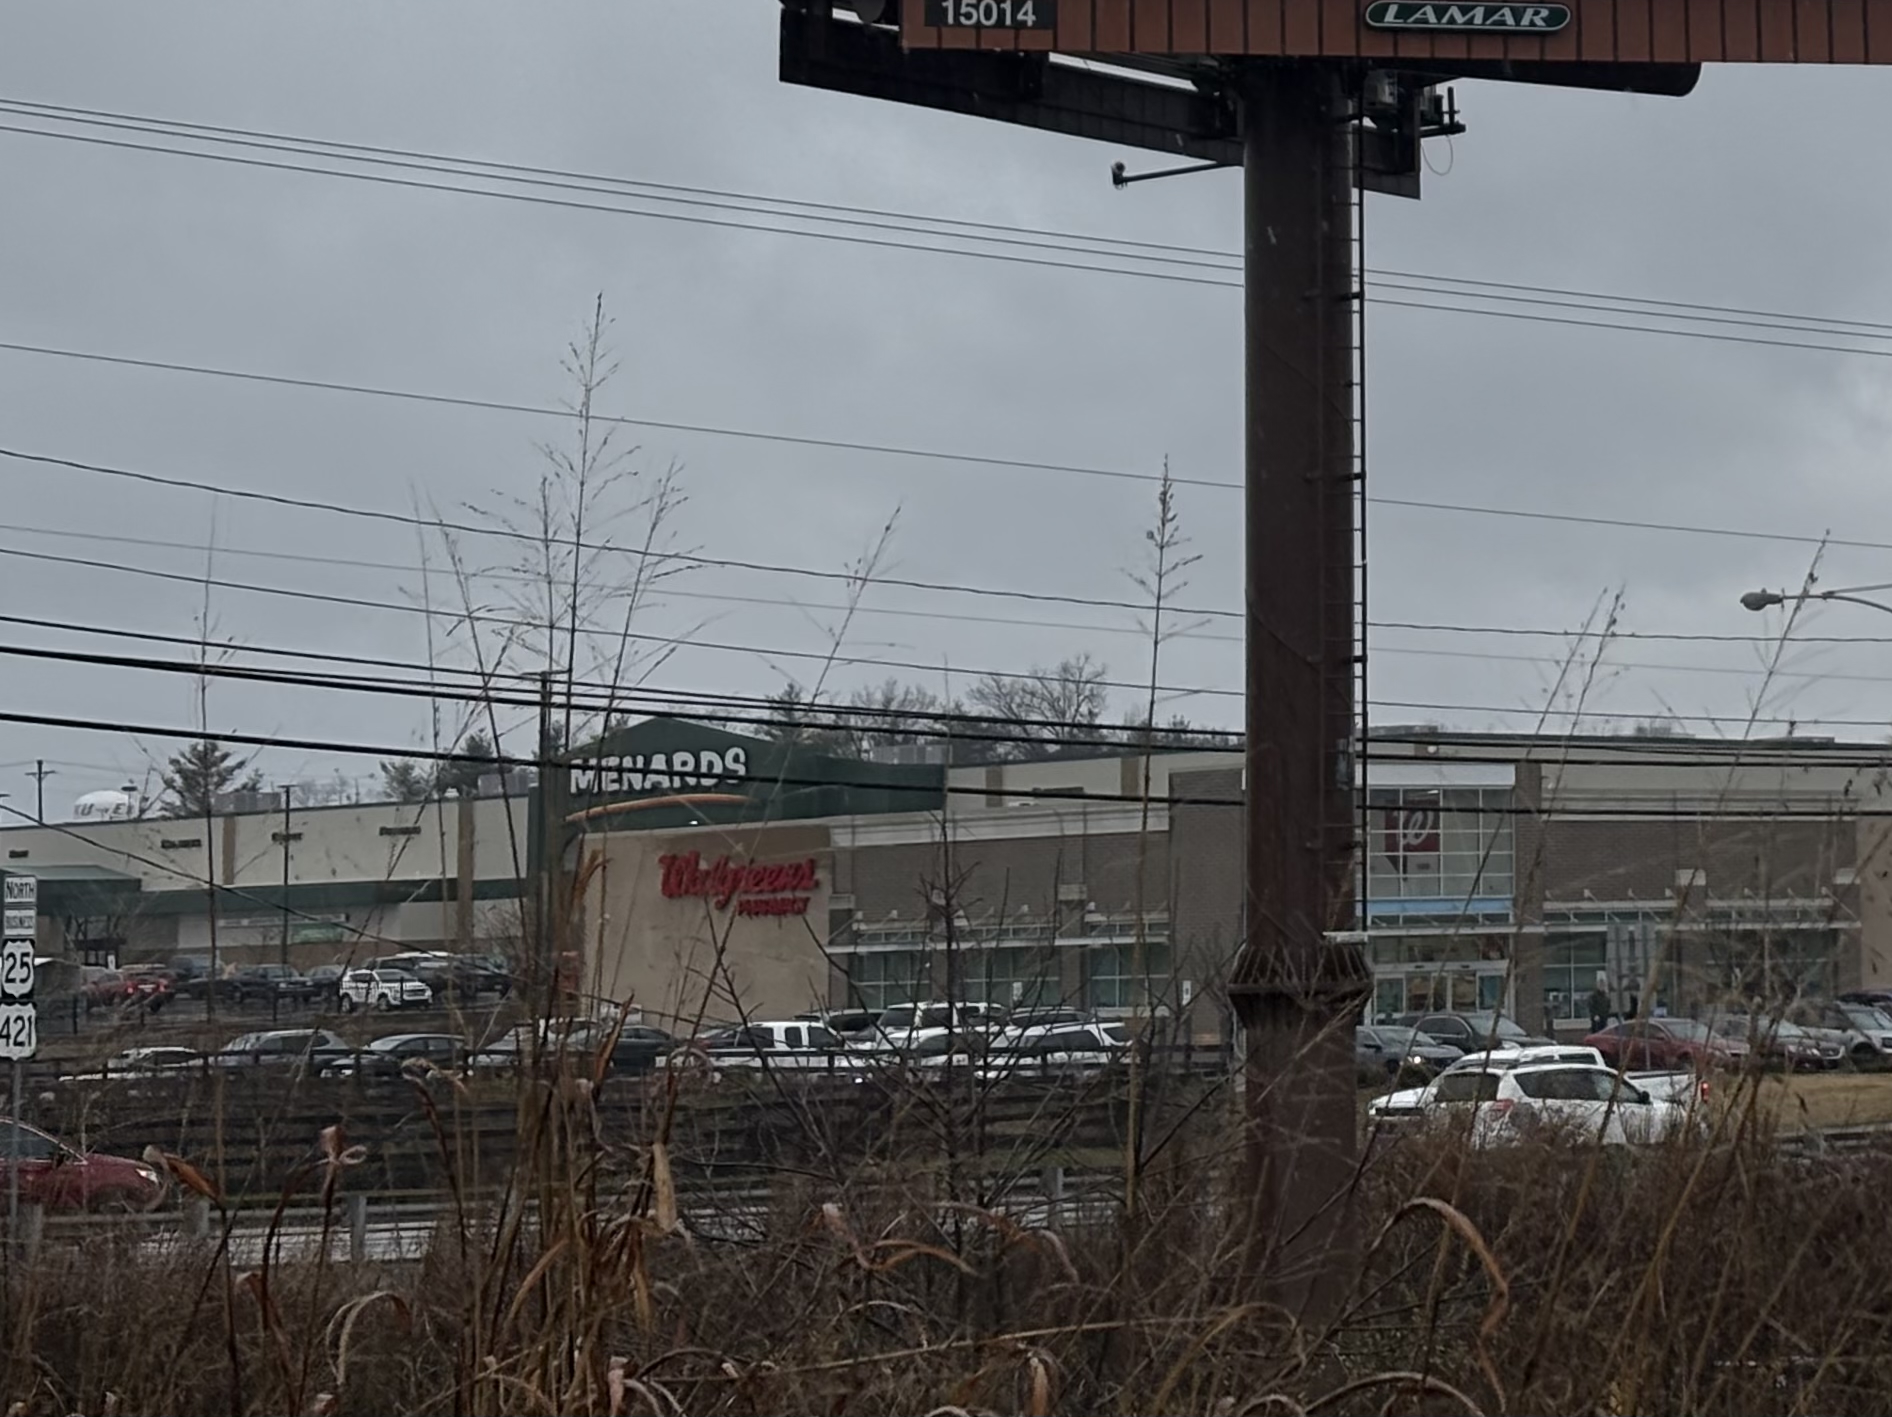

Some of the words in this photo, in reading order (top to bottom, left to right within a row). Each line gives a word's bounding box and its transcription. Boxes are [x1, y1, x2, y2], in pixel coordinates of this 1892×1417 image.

[1384, 4, 1549, 26] LAMAR
[570, 747, 747, 795] MENARDS
[6, 881, 35, 899] NORTH
[658, 851, 820, 910] Walgreens
[5, 952, 31, 984] 25
[0, 1015, 32, 1047] 421
